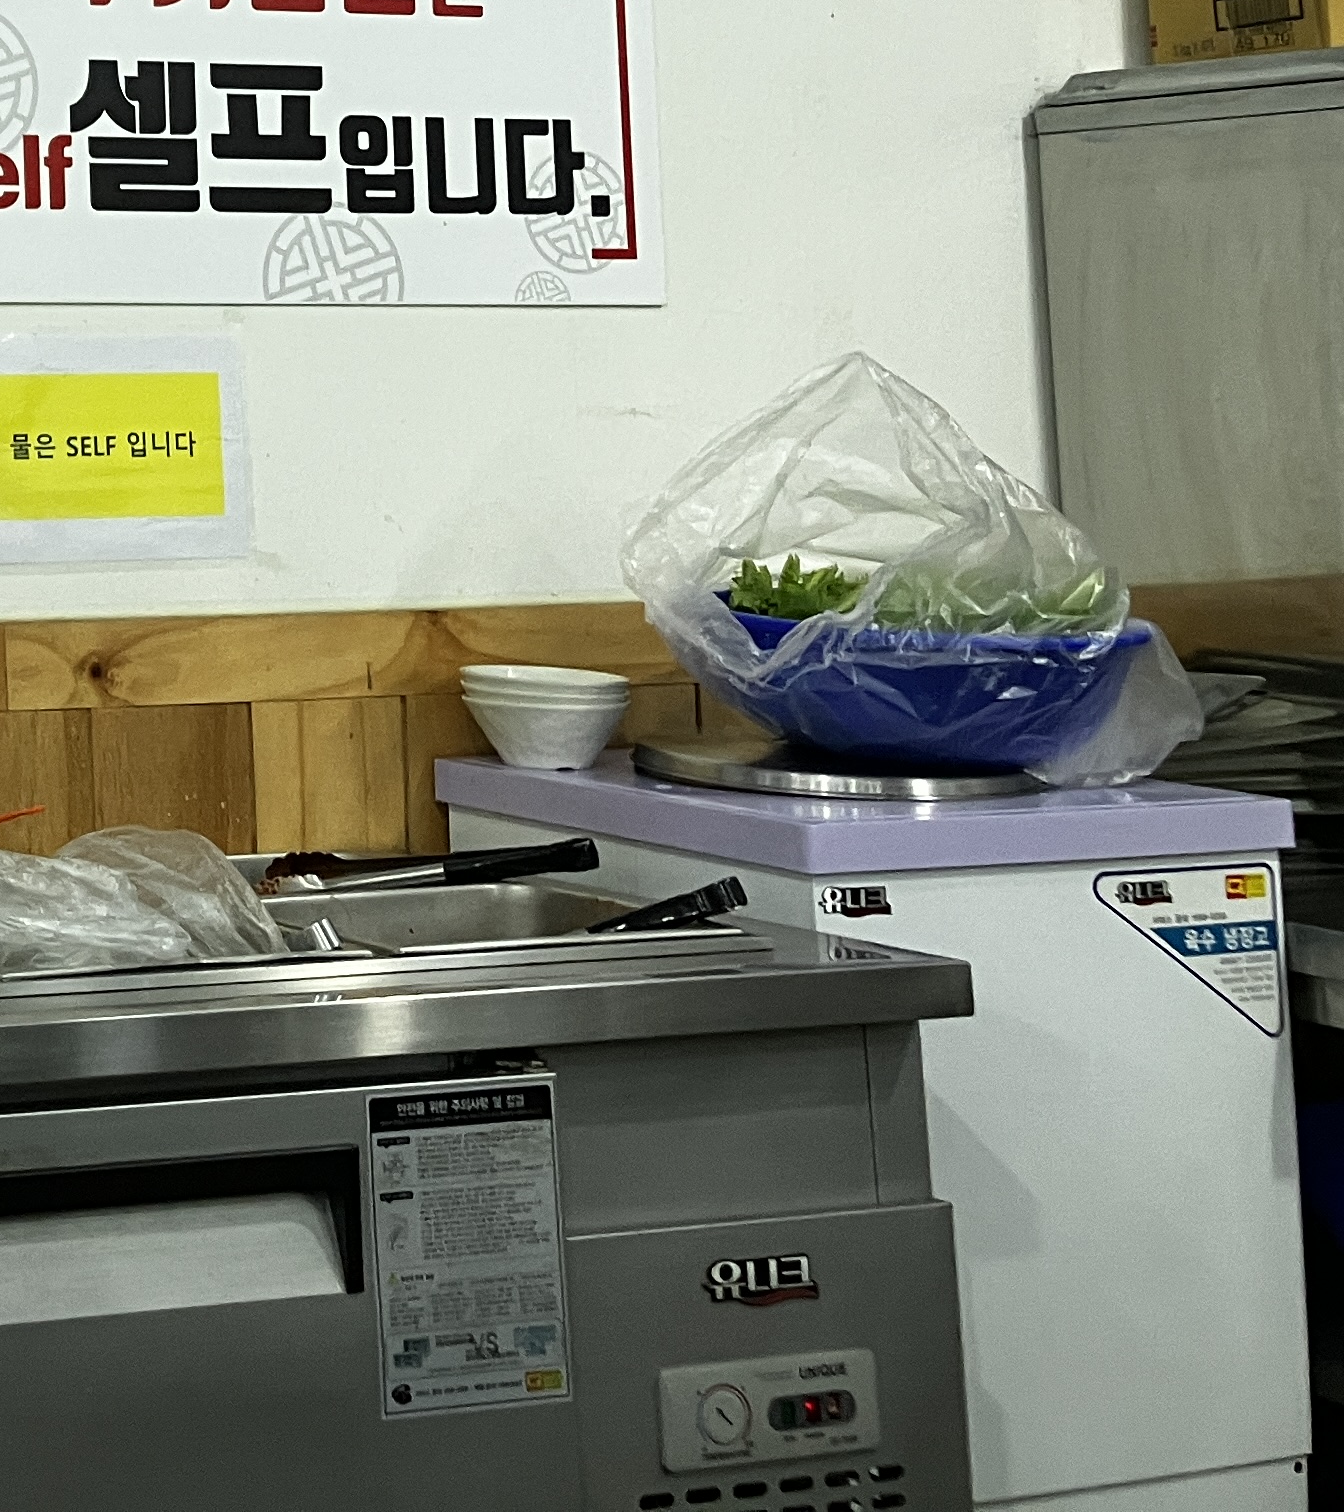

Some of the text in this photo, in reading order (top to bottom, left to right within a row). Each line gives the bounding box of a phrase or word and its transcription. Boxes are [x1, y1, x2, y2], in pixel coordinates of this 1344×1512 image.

[68, 59, 611, 218] 셀프입니다.
[9, 430, 197, 460] 물은 SELF 입니다
[1223, 925, 1270, 951] 냉장고
